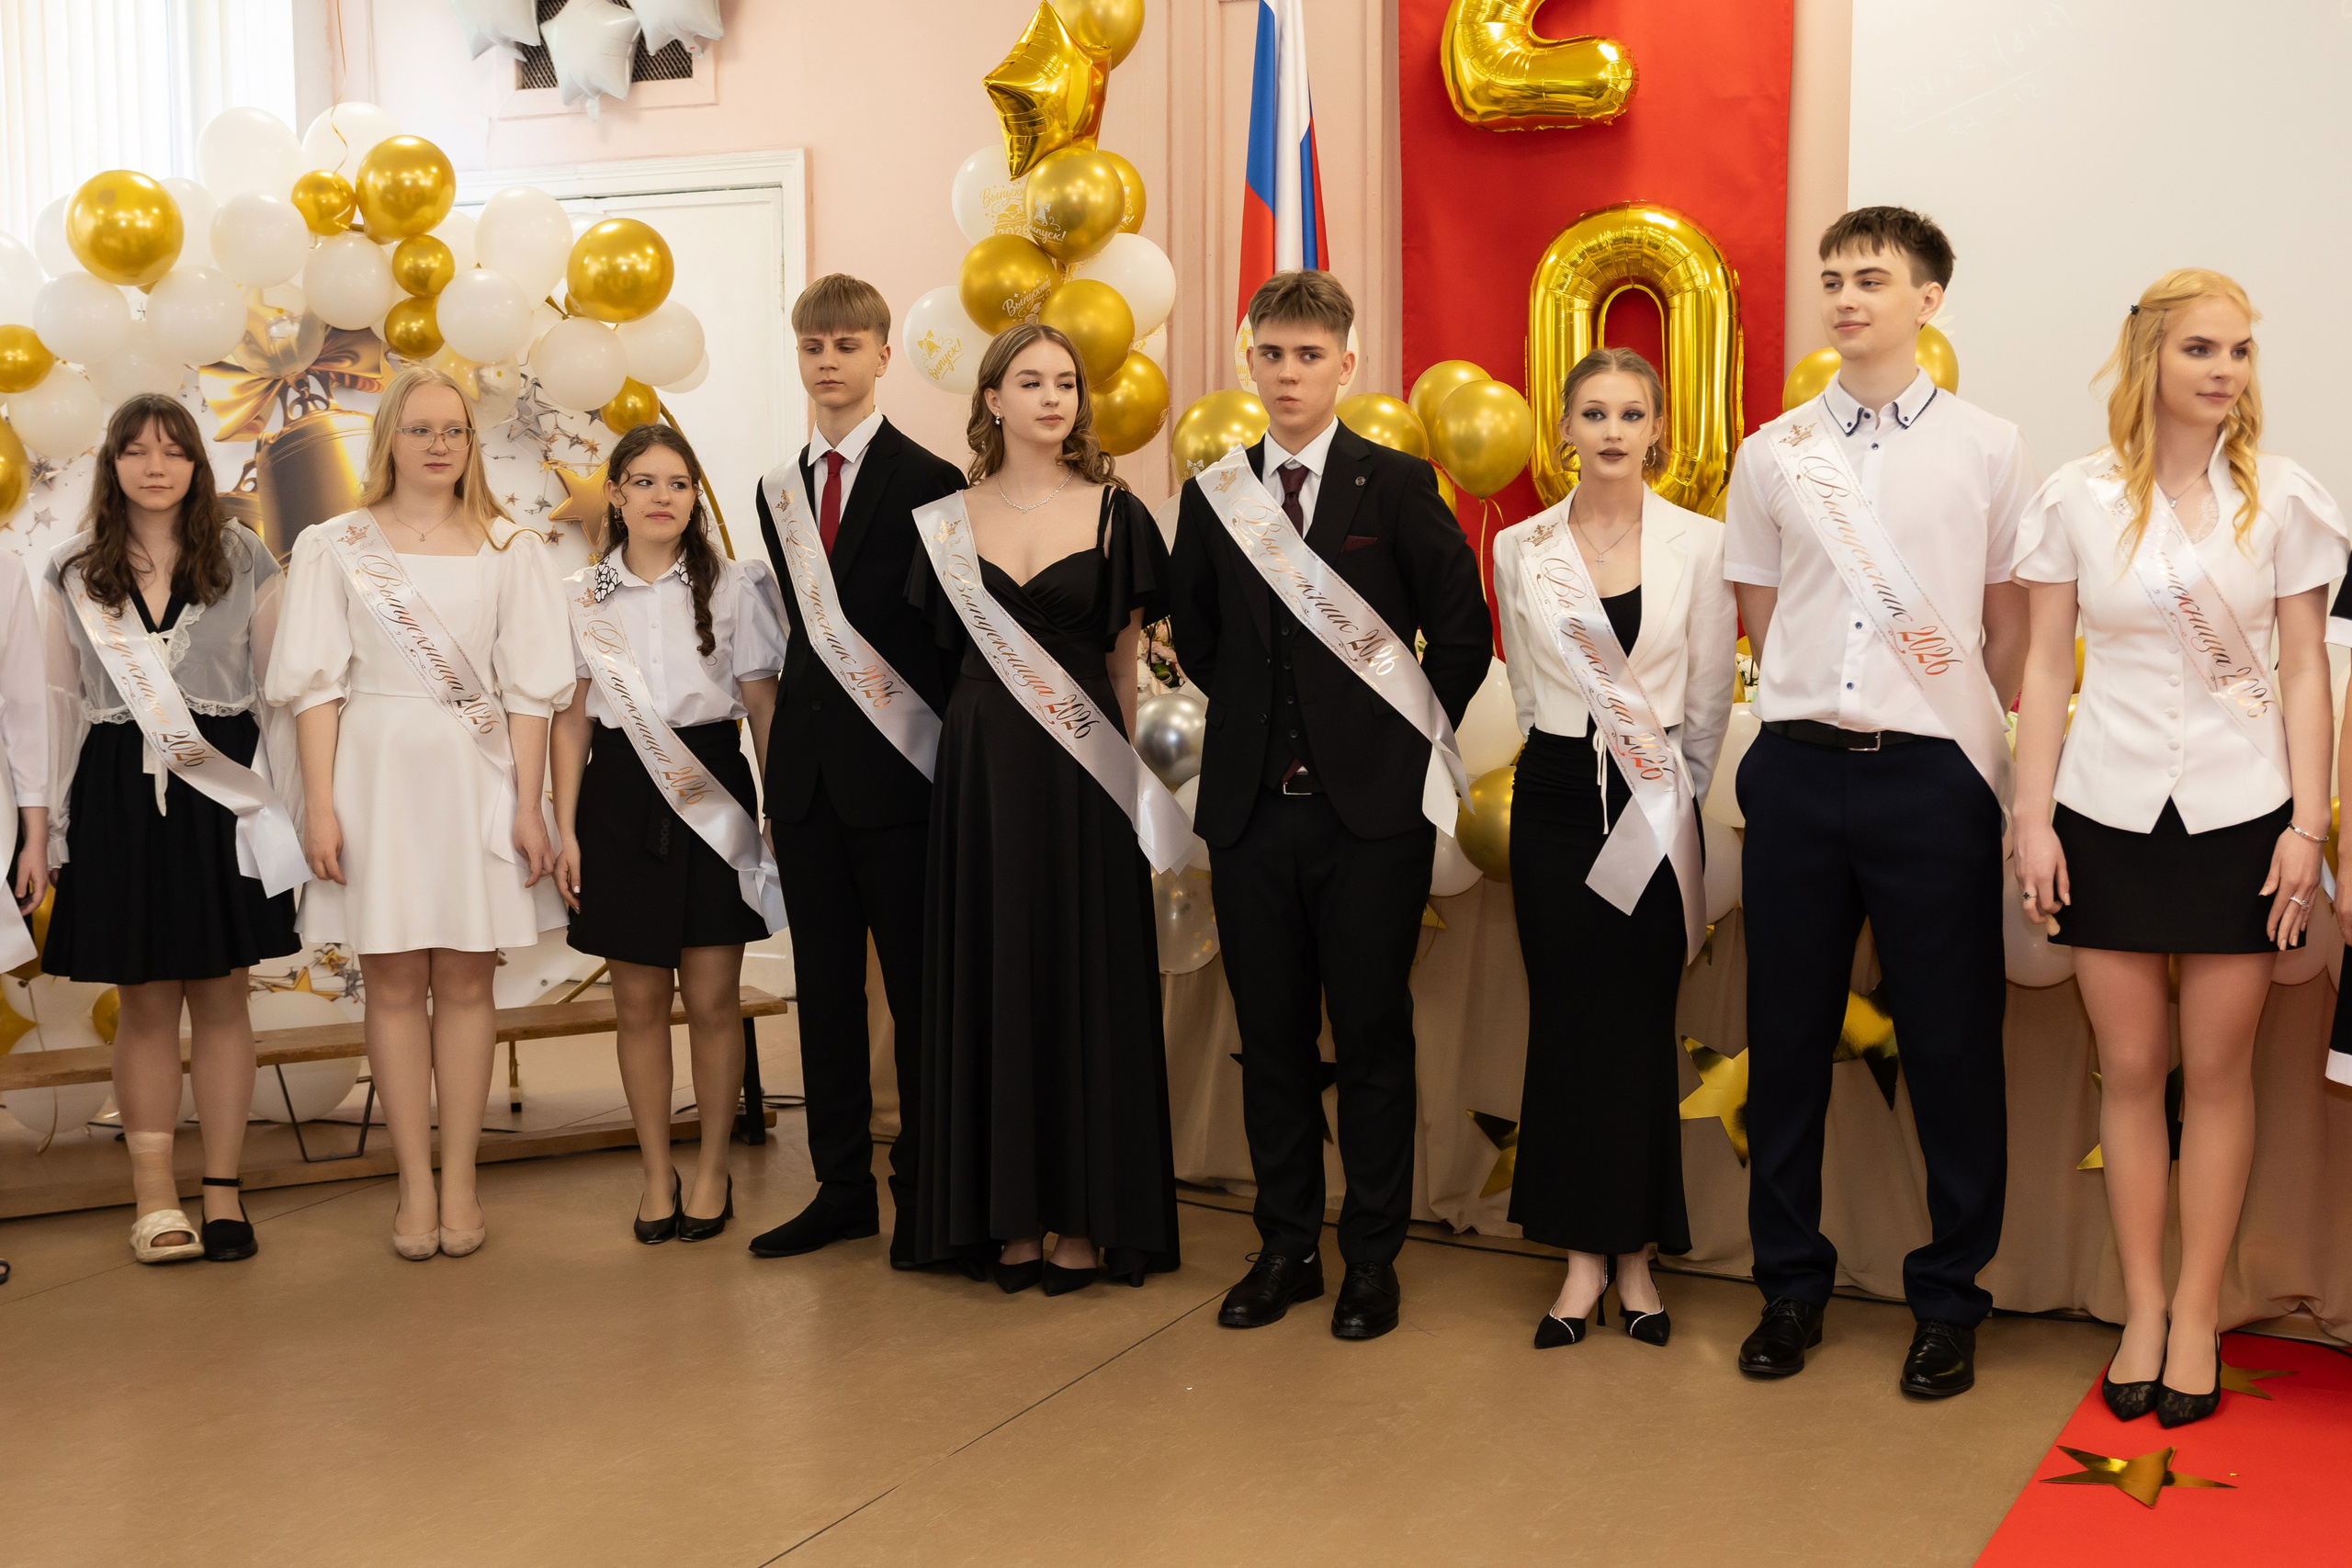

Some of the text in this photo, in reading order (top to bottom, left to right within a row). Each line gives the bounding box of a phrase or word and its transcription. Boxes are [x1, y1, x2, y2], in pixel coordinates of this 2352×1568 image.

[979, 186, 1025, 209] Выпускн
[1002, 274, 1051, 317] Выпускной
[928, 338, 962, 380] Выпуск!
[786, 520, 903, 708] Выпускник 2026
[1232, 497, 1399, 676] Выпускник 2026
[1799, 456, 1963, 676] Выпускник 2026
[357, 554, 501, 735] Выпускница 2026
[946, 553, 1101, 739] Выпускница 2026
[1538, 558, 1677, 782] Выпускница 2026
[2217, 666, 2276, 719] 2026
[160, 730, 216, 767] 2026
[662, 766, 715, 806] 2026
